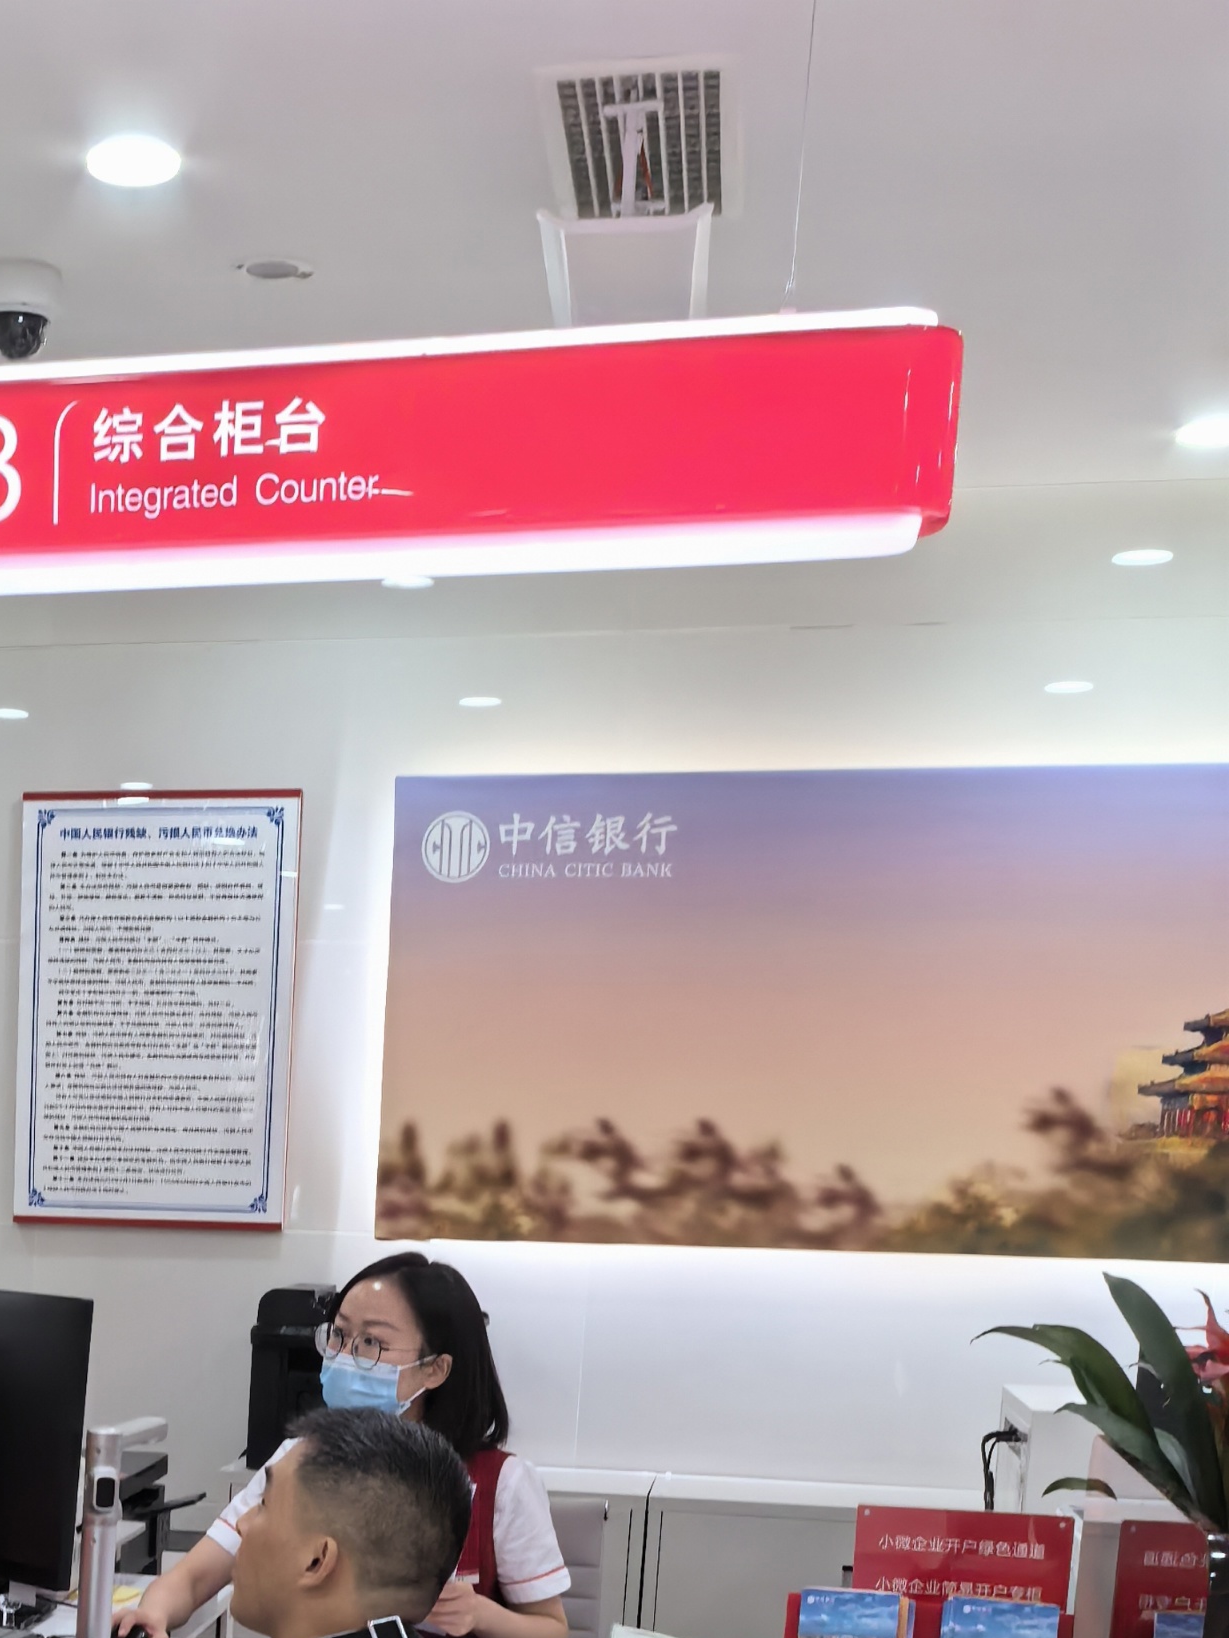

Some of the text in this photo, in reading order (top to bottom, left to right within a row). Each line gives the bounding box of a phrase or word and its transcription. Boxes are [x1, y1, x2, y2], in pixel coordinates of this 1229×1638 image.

[92, 396, 326, 464] 综合柜台
[89, 472, 379, 520] Integrated Counter
[498, 812, 678, 856] 中信银行
[498, 862, 673, 878] CHINA CITIC BANK
[878, 1533, 1047, 1560] 小微企业开户绿色通道
